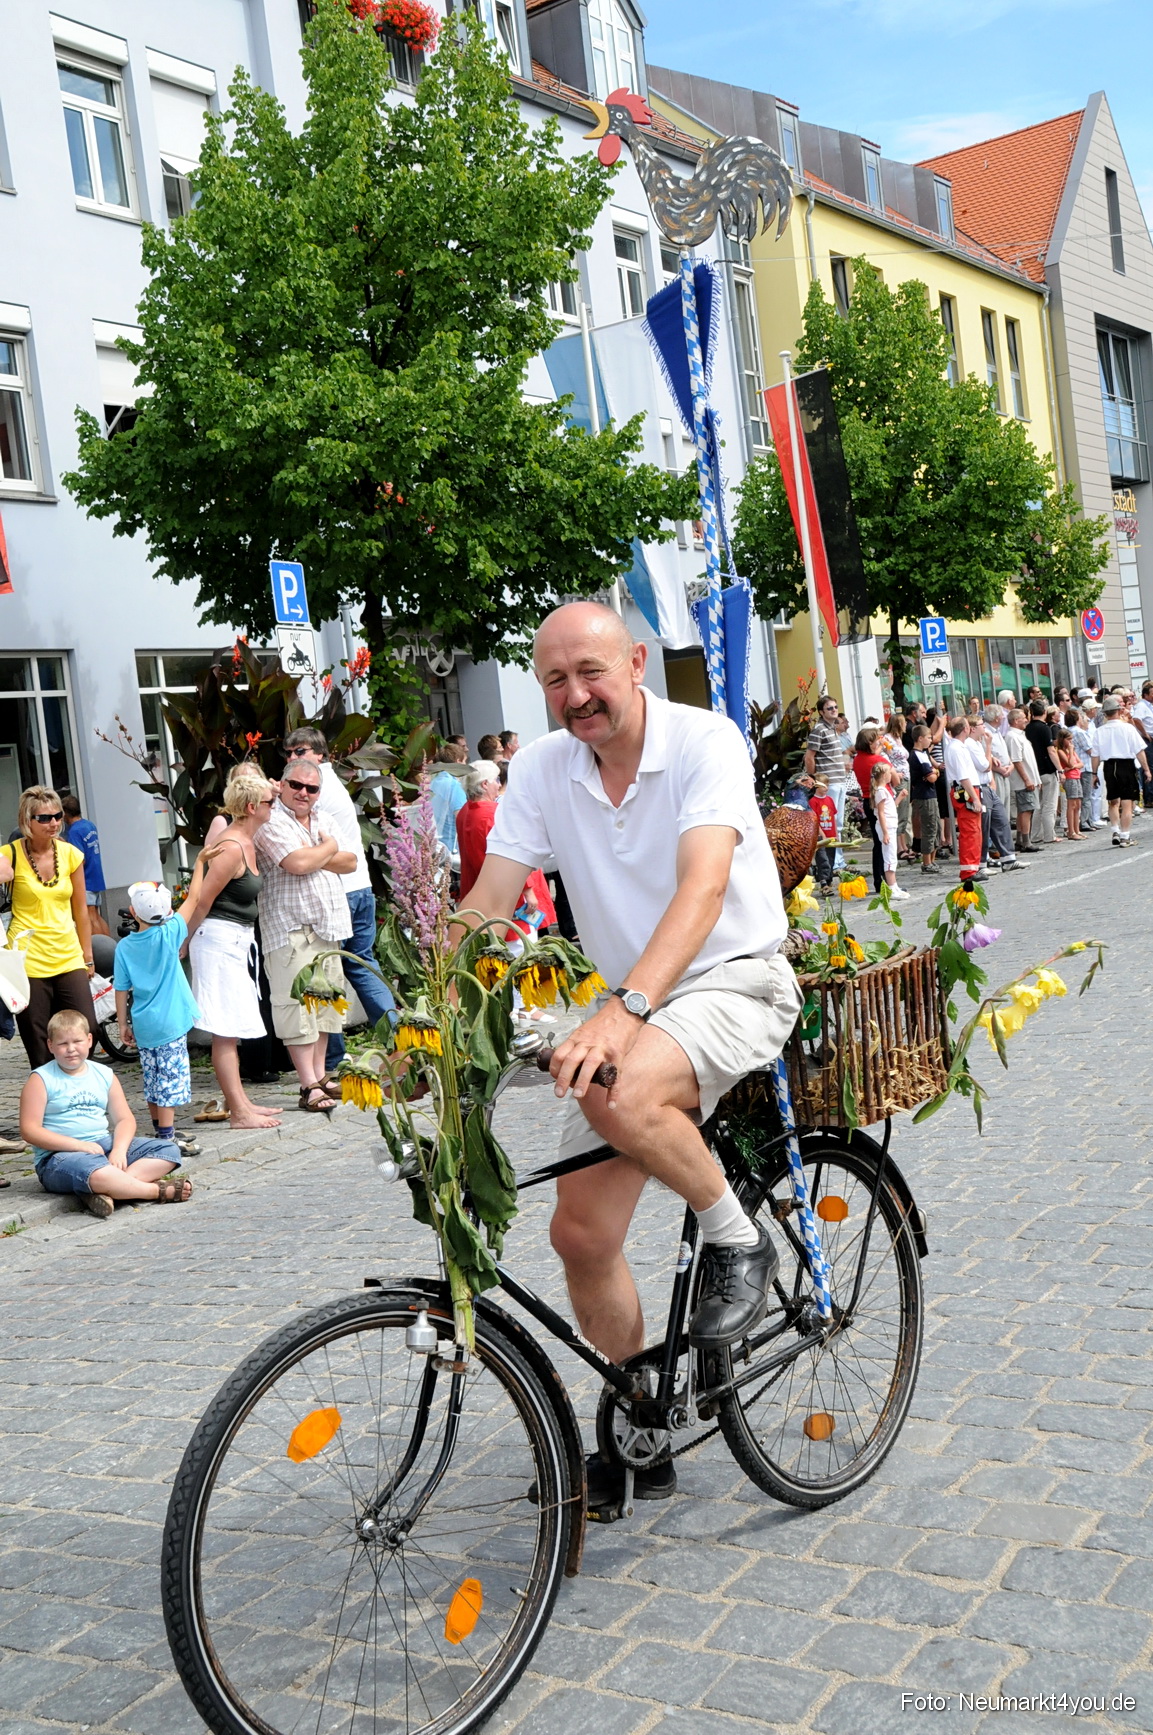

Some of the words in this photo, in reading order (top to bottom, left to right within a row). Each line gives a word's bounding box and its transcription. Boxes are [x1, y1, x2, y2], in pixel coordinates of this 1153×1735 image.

[1113, 488, 1138, 513] stadt
[279, 569, 298, 615] P
[289, 632, 302, 642] nur
[926, 622, 940, 649] P
